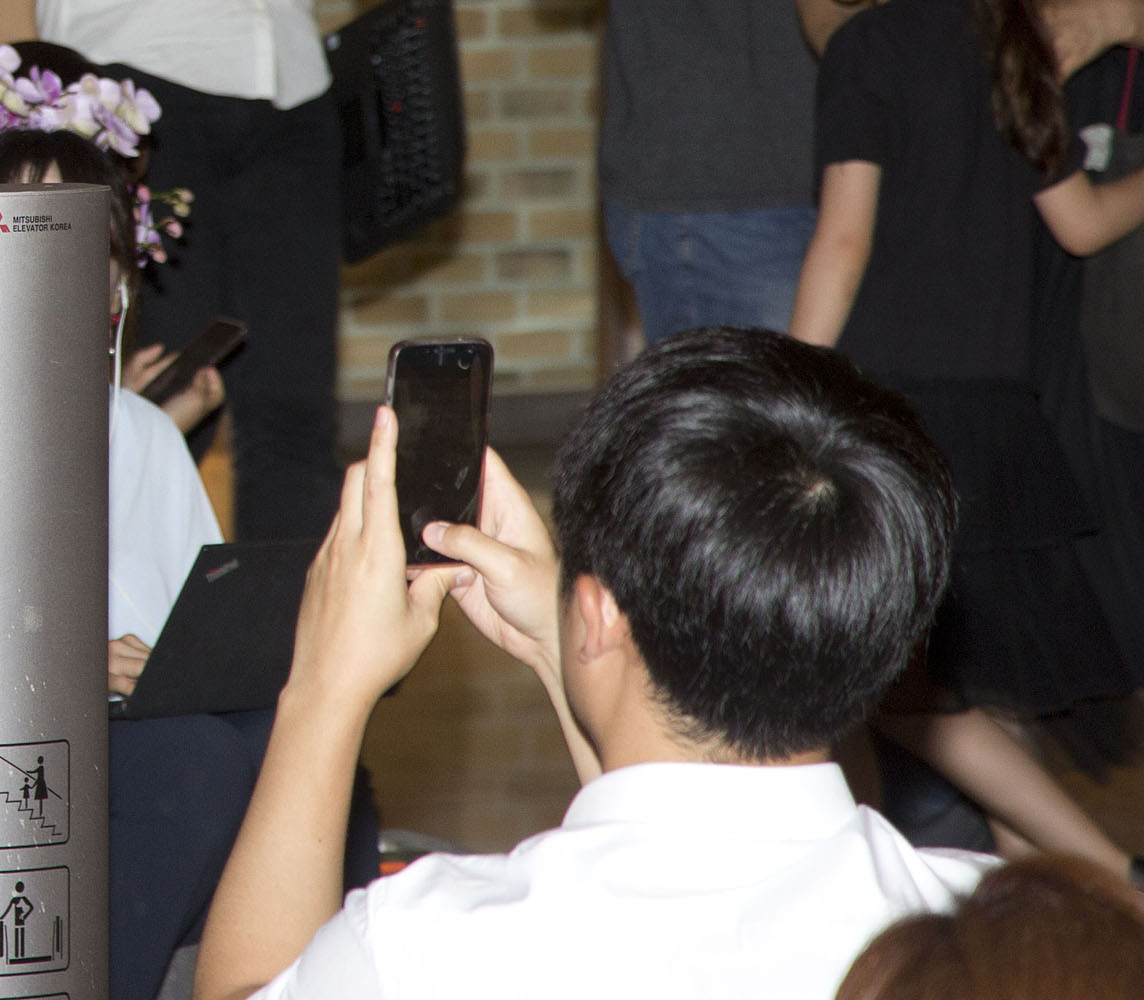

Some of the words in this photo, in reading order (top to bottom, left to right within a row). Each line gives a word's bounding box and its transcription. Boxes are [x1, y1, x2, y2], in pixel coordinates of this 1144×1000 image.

[12, 215, 53, 224] MITSUBISHI
[12, 224, 49, 232] ELEVATOR
[50, 222, 72, 231] KOREA
